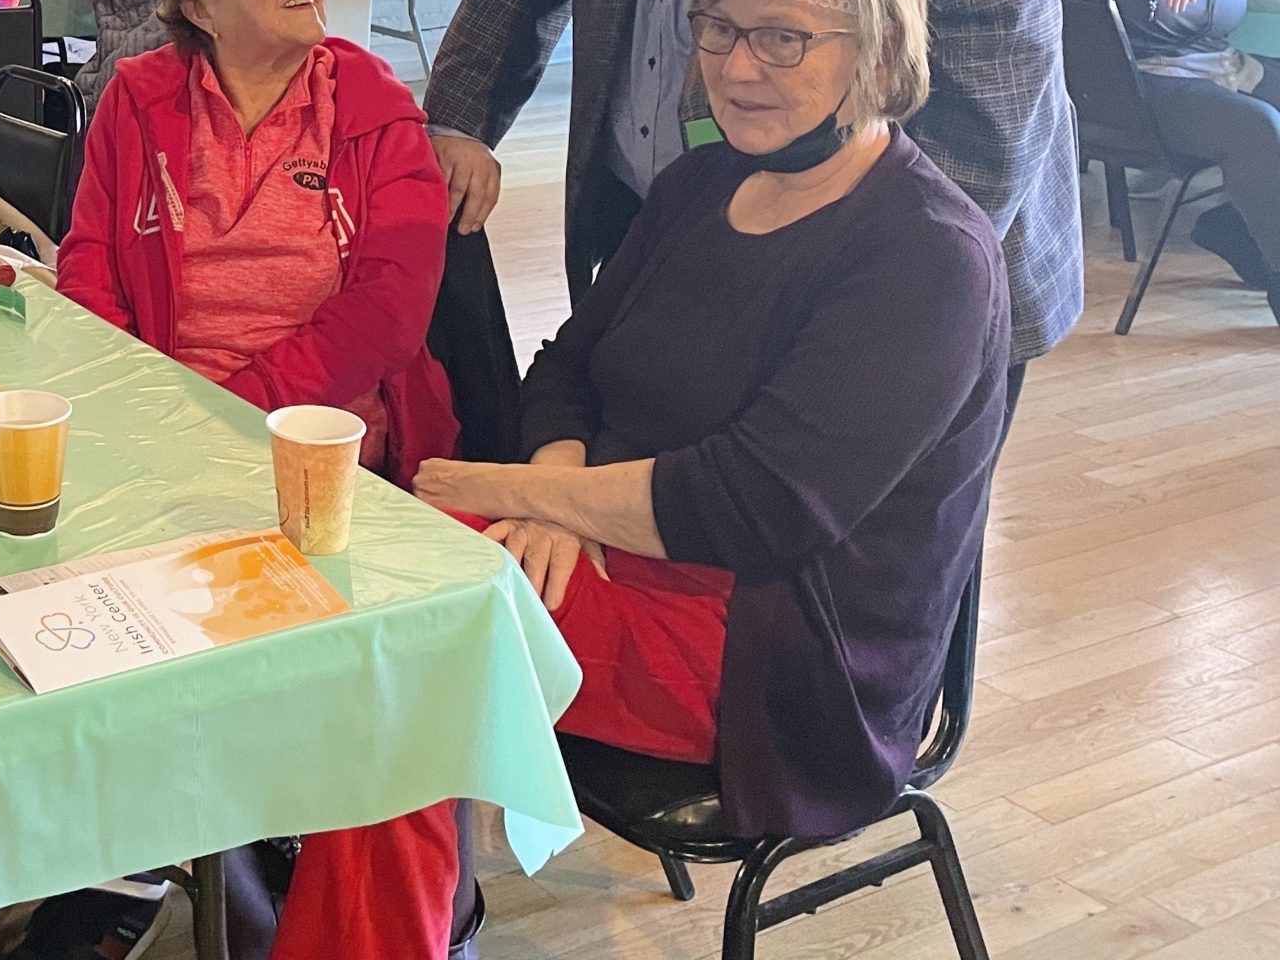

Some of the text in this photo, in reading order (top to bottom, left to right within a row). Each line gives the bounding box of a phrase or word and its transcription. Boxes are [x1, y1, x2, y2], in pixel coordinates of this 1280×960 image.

[282, 158, 328, 172] Gettysb
[302, 174, 320, 188] PA
[75, 593, 128, 653] New York
[88, 583, 153, 655] Irish Center
